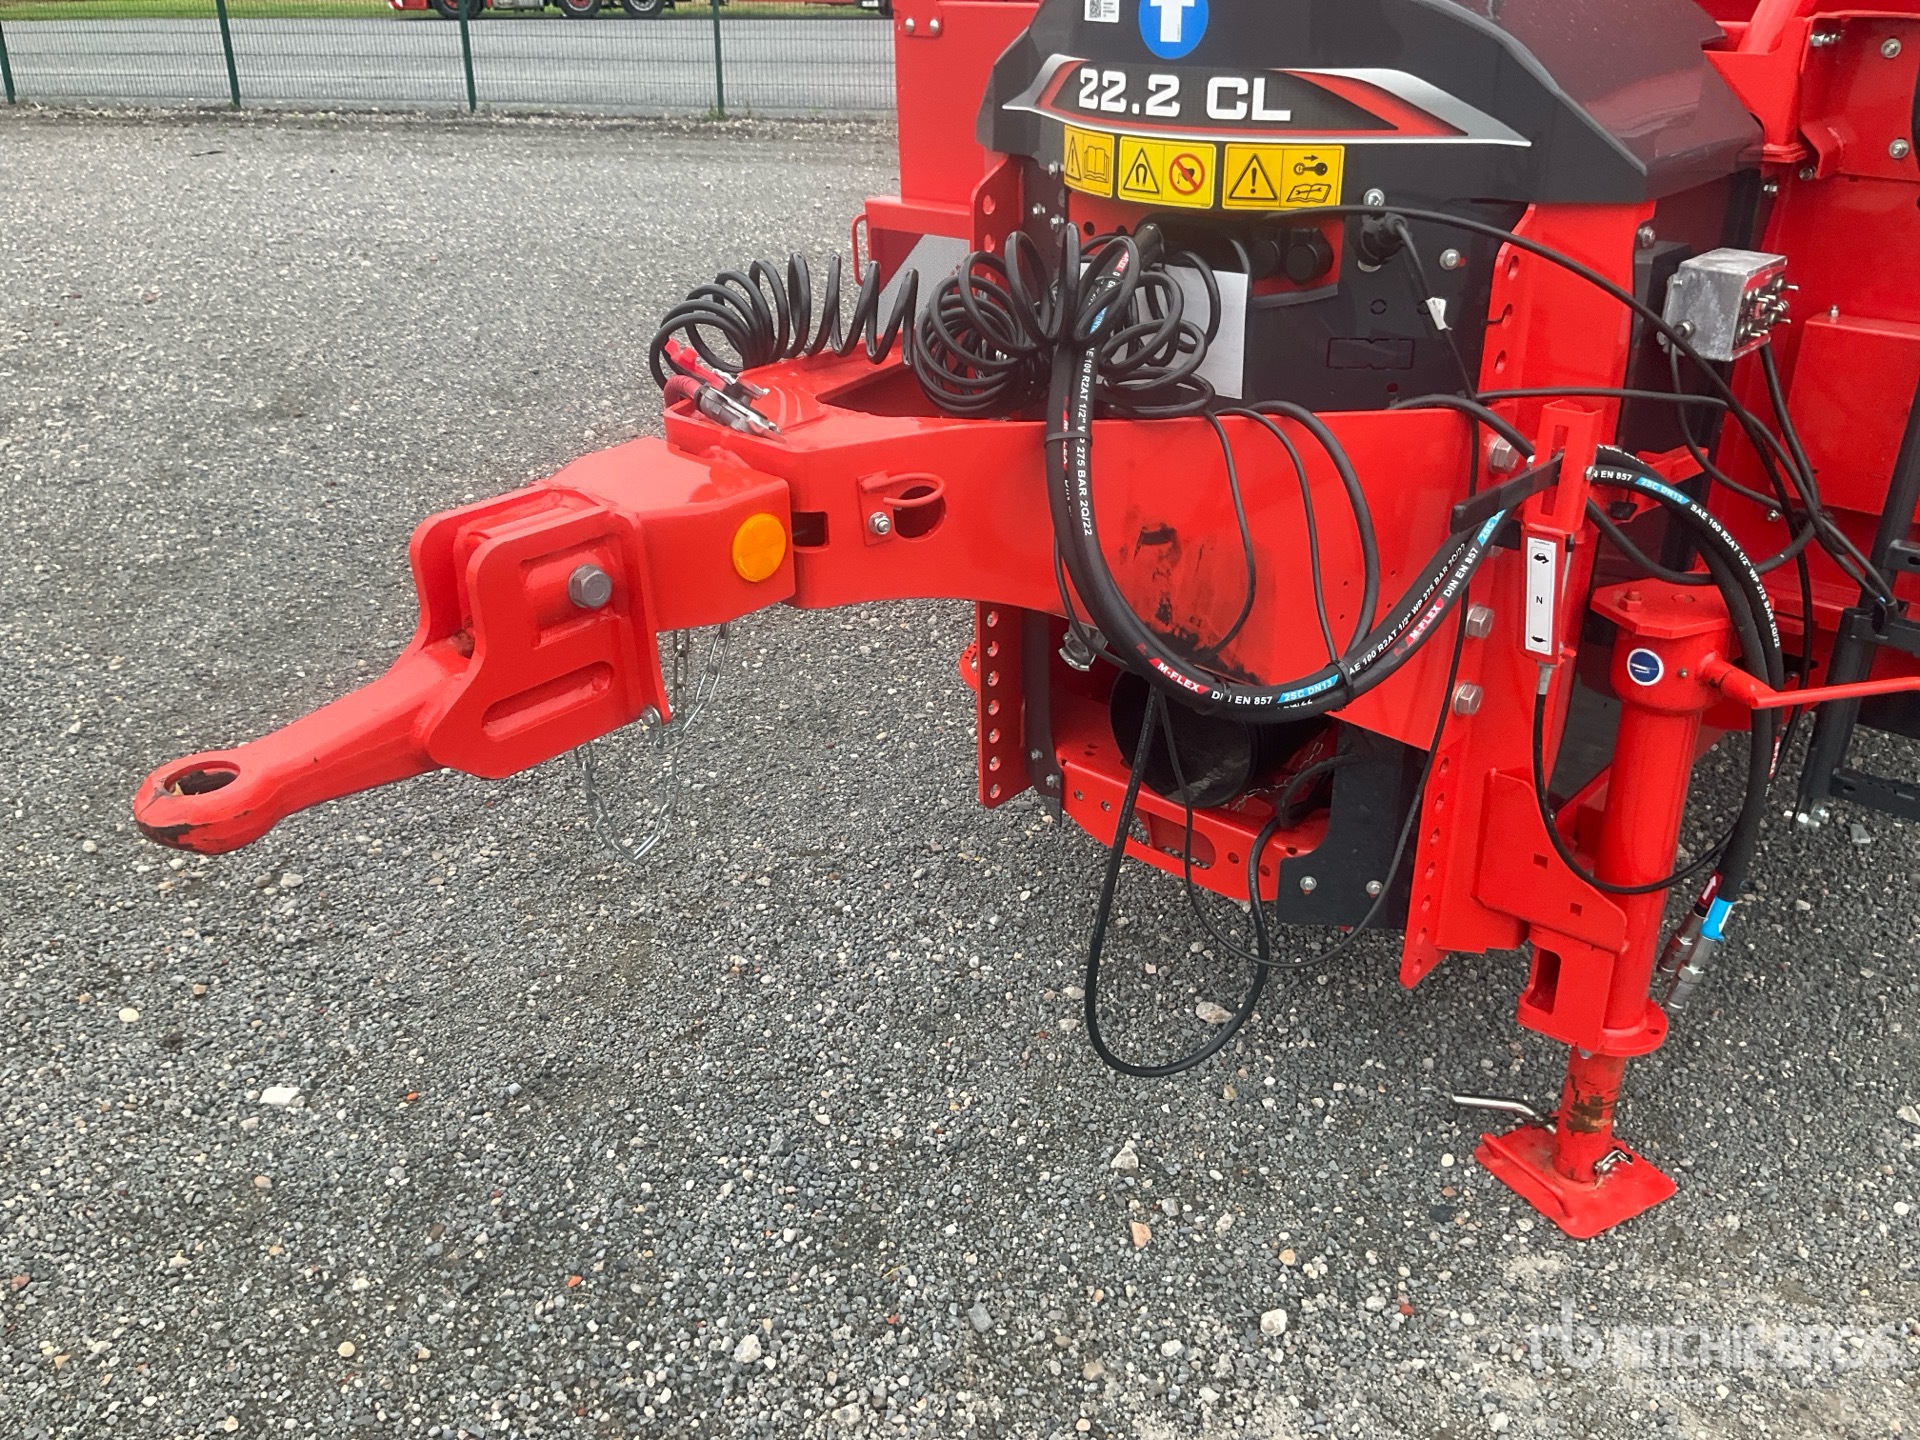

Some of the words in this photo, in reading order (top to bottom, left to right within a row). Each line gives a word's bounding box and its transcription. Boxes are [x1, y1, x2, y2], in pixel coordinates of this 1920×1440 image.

[1079, 68, 1180, 117] 22.2
[1206, 77, 1291, 121] CL
[1083, 360, 1092, 373] 100
[1080, 375, 1090, 401] R2AT
[1077, 446, 1085, 467] 275
[1078, 470, 1087, 496] BAR
[1080, 500, 1092, 536] 2Q/22
[1600, 470, 1614, 479] EN
[1616, 472, 1632, 481] 857
[1690, 504, 1708, 521] SAE
[1708, 518, 1722, 533] 100
[1721, 530, 1740, 552] R2AT
[1749, 568, 1760, 583] WP
[1756, 584, 1768, 600] 275
[1763, 601, 1774, 621] BAR
[1409, 604, 1443, 640] M-FLEX
[1443, 580, 1459, 598] DIN
[1455, 563, 1469, 579] EN
[1464, 547, 1479, 564] 857
[1536, 596, 1543, 605] N
[1157, 662, 1202, 693] M-FLEX
[1235, 695, 1250, 705] EN
[1254, 696, 1273, 705] 857
[1284, 689, 1305, 702] 2SC
[1307, 680, 1333, 695] DN13
[1363, 651, 1378, 665] 100
[1377, 629, 1398, 652] R2AT
[1410, 599, 1423, 615] WP
[1434, 565, 1449, 586] BAR
